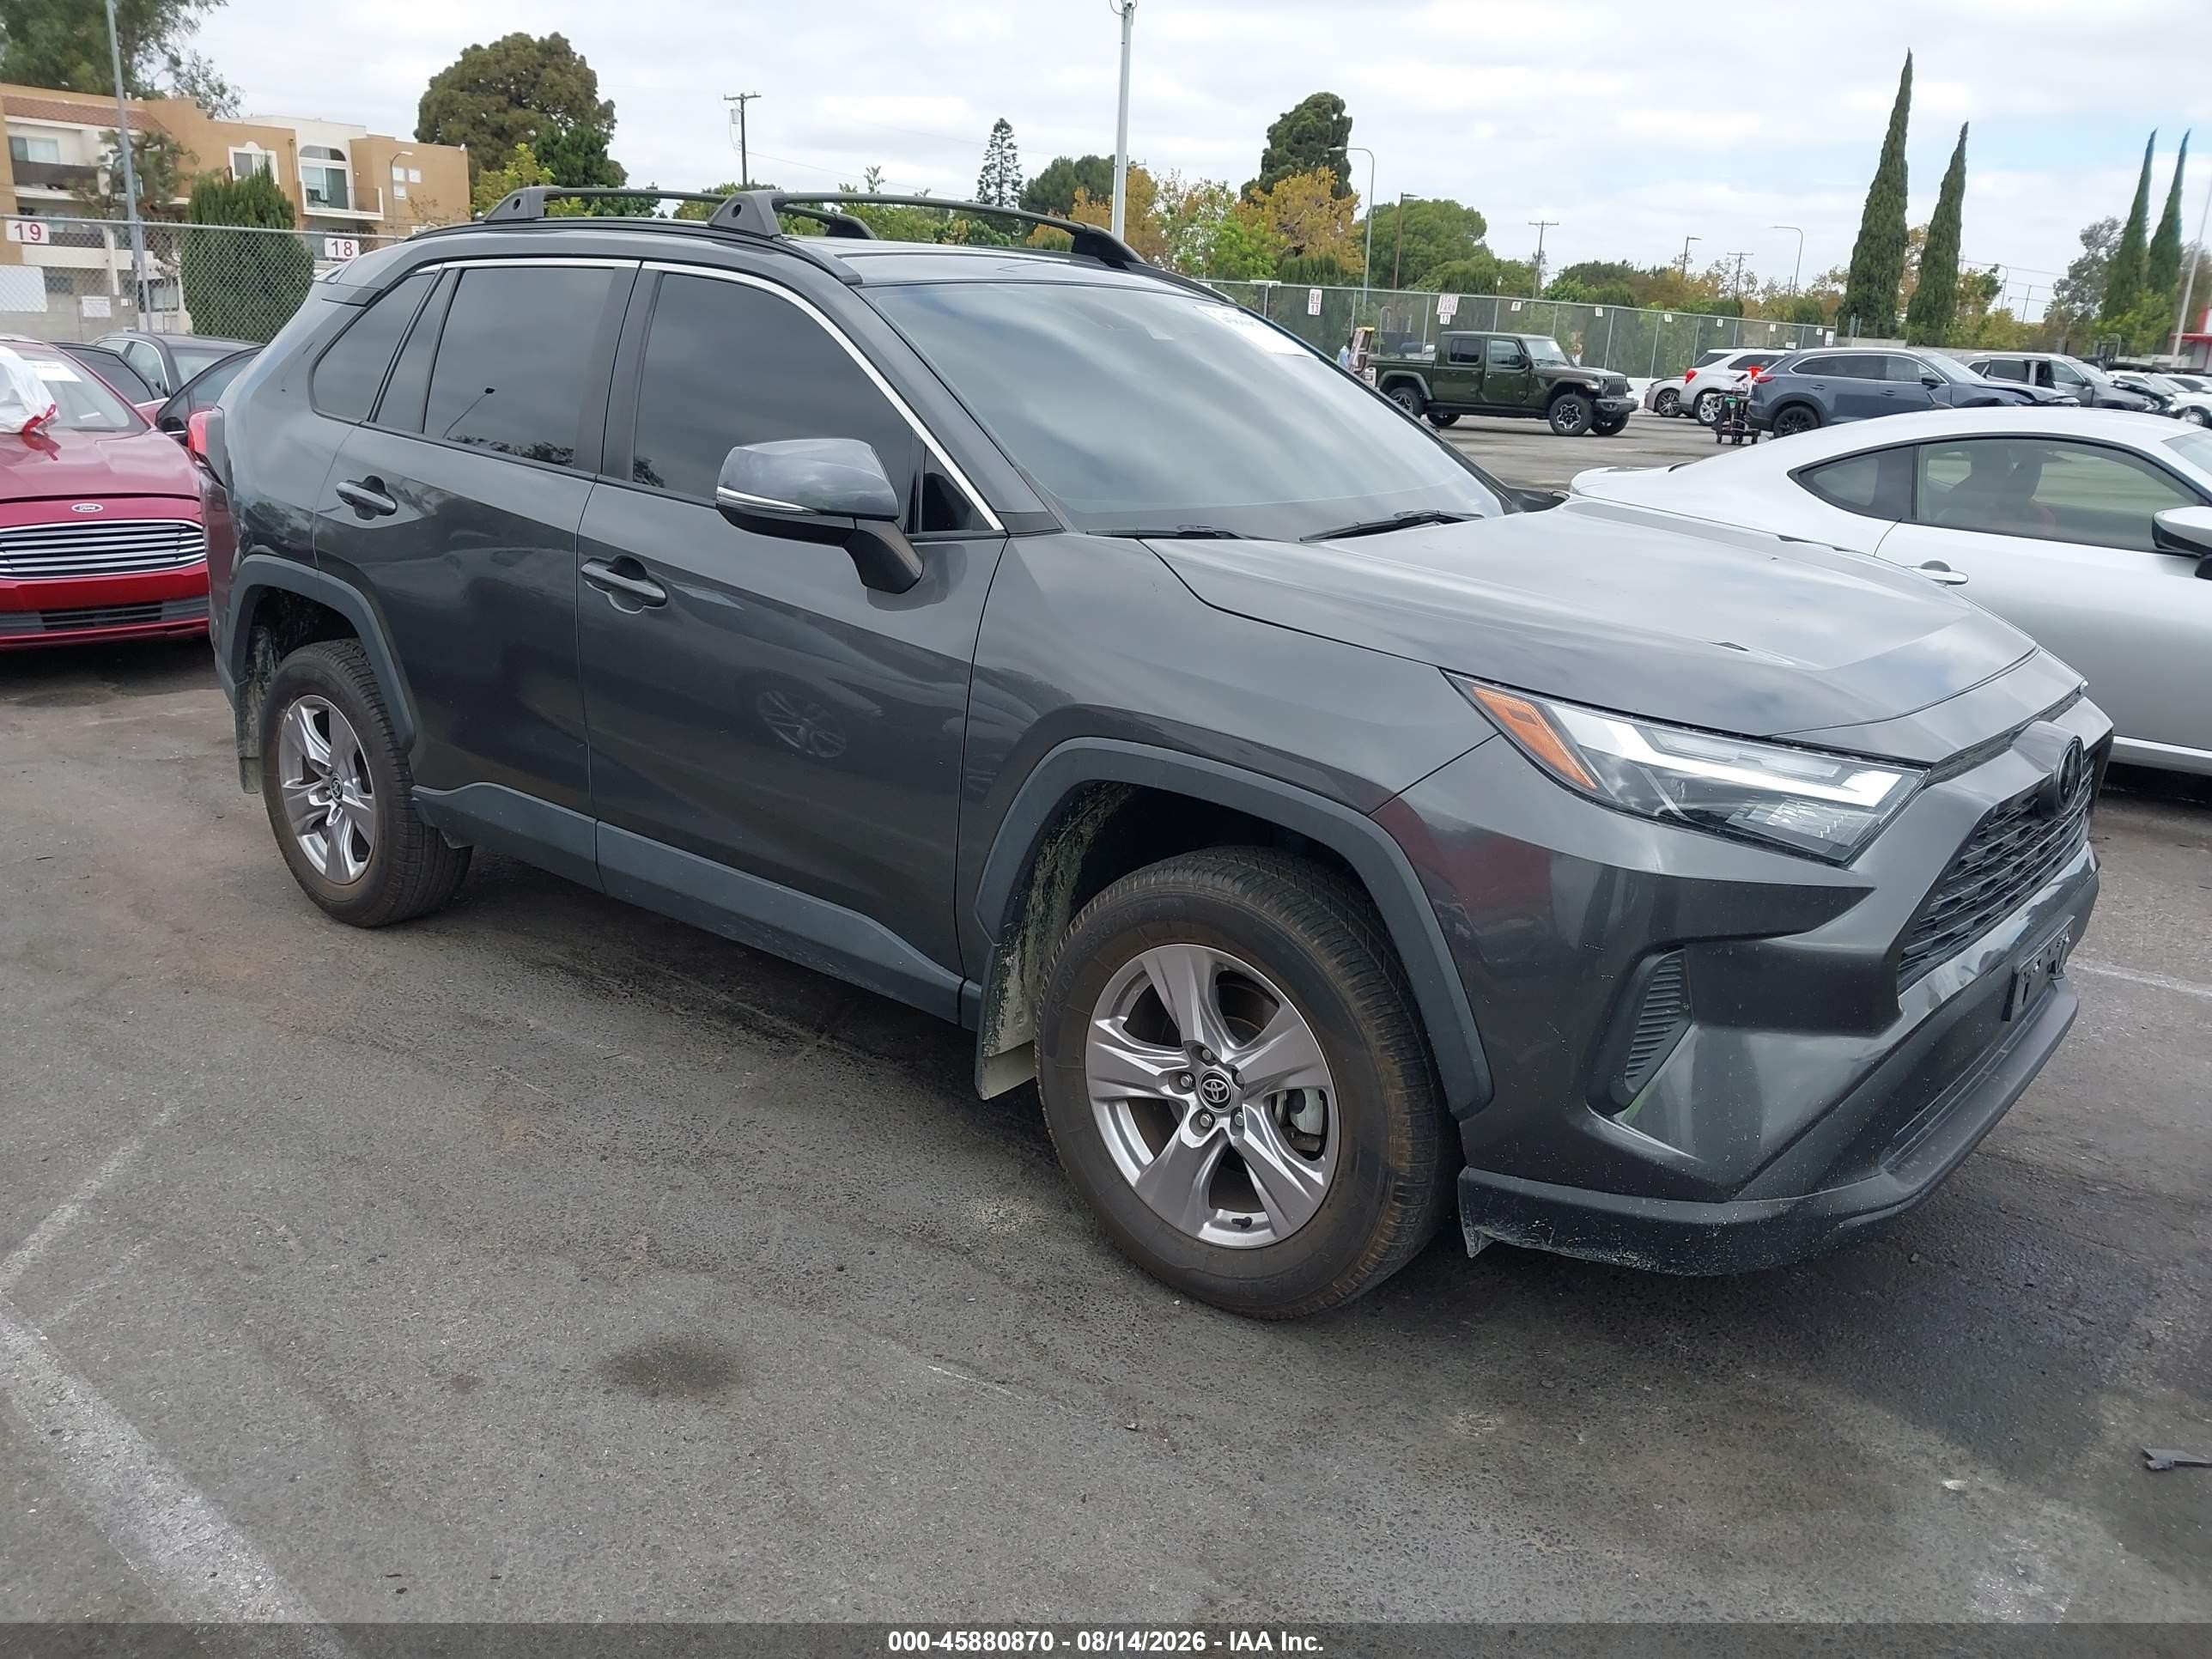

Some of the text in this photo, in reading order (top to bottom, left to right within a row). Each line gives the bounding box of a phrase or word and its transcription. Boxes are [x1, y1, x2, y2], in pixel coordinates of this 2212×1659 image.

[15, 222, 41, 240] 19
[331, 240, 353, 257] 18
[1443, 314, 1449, 324] 12
